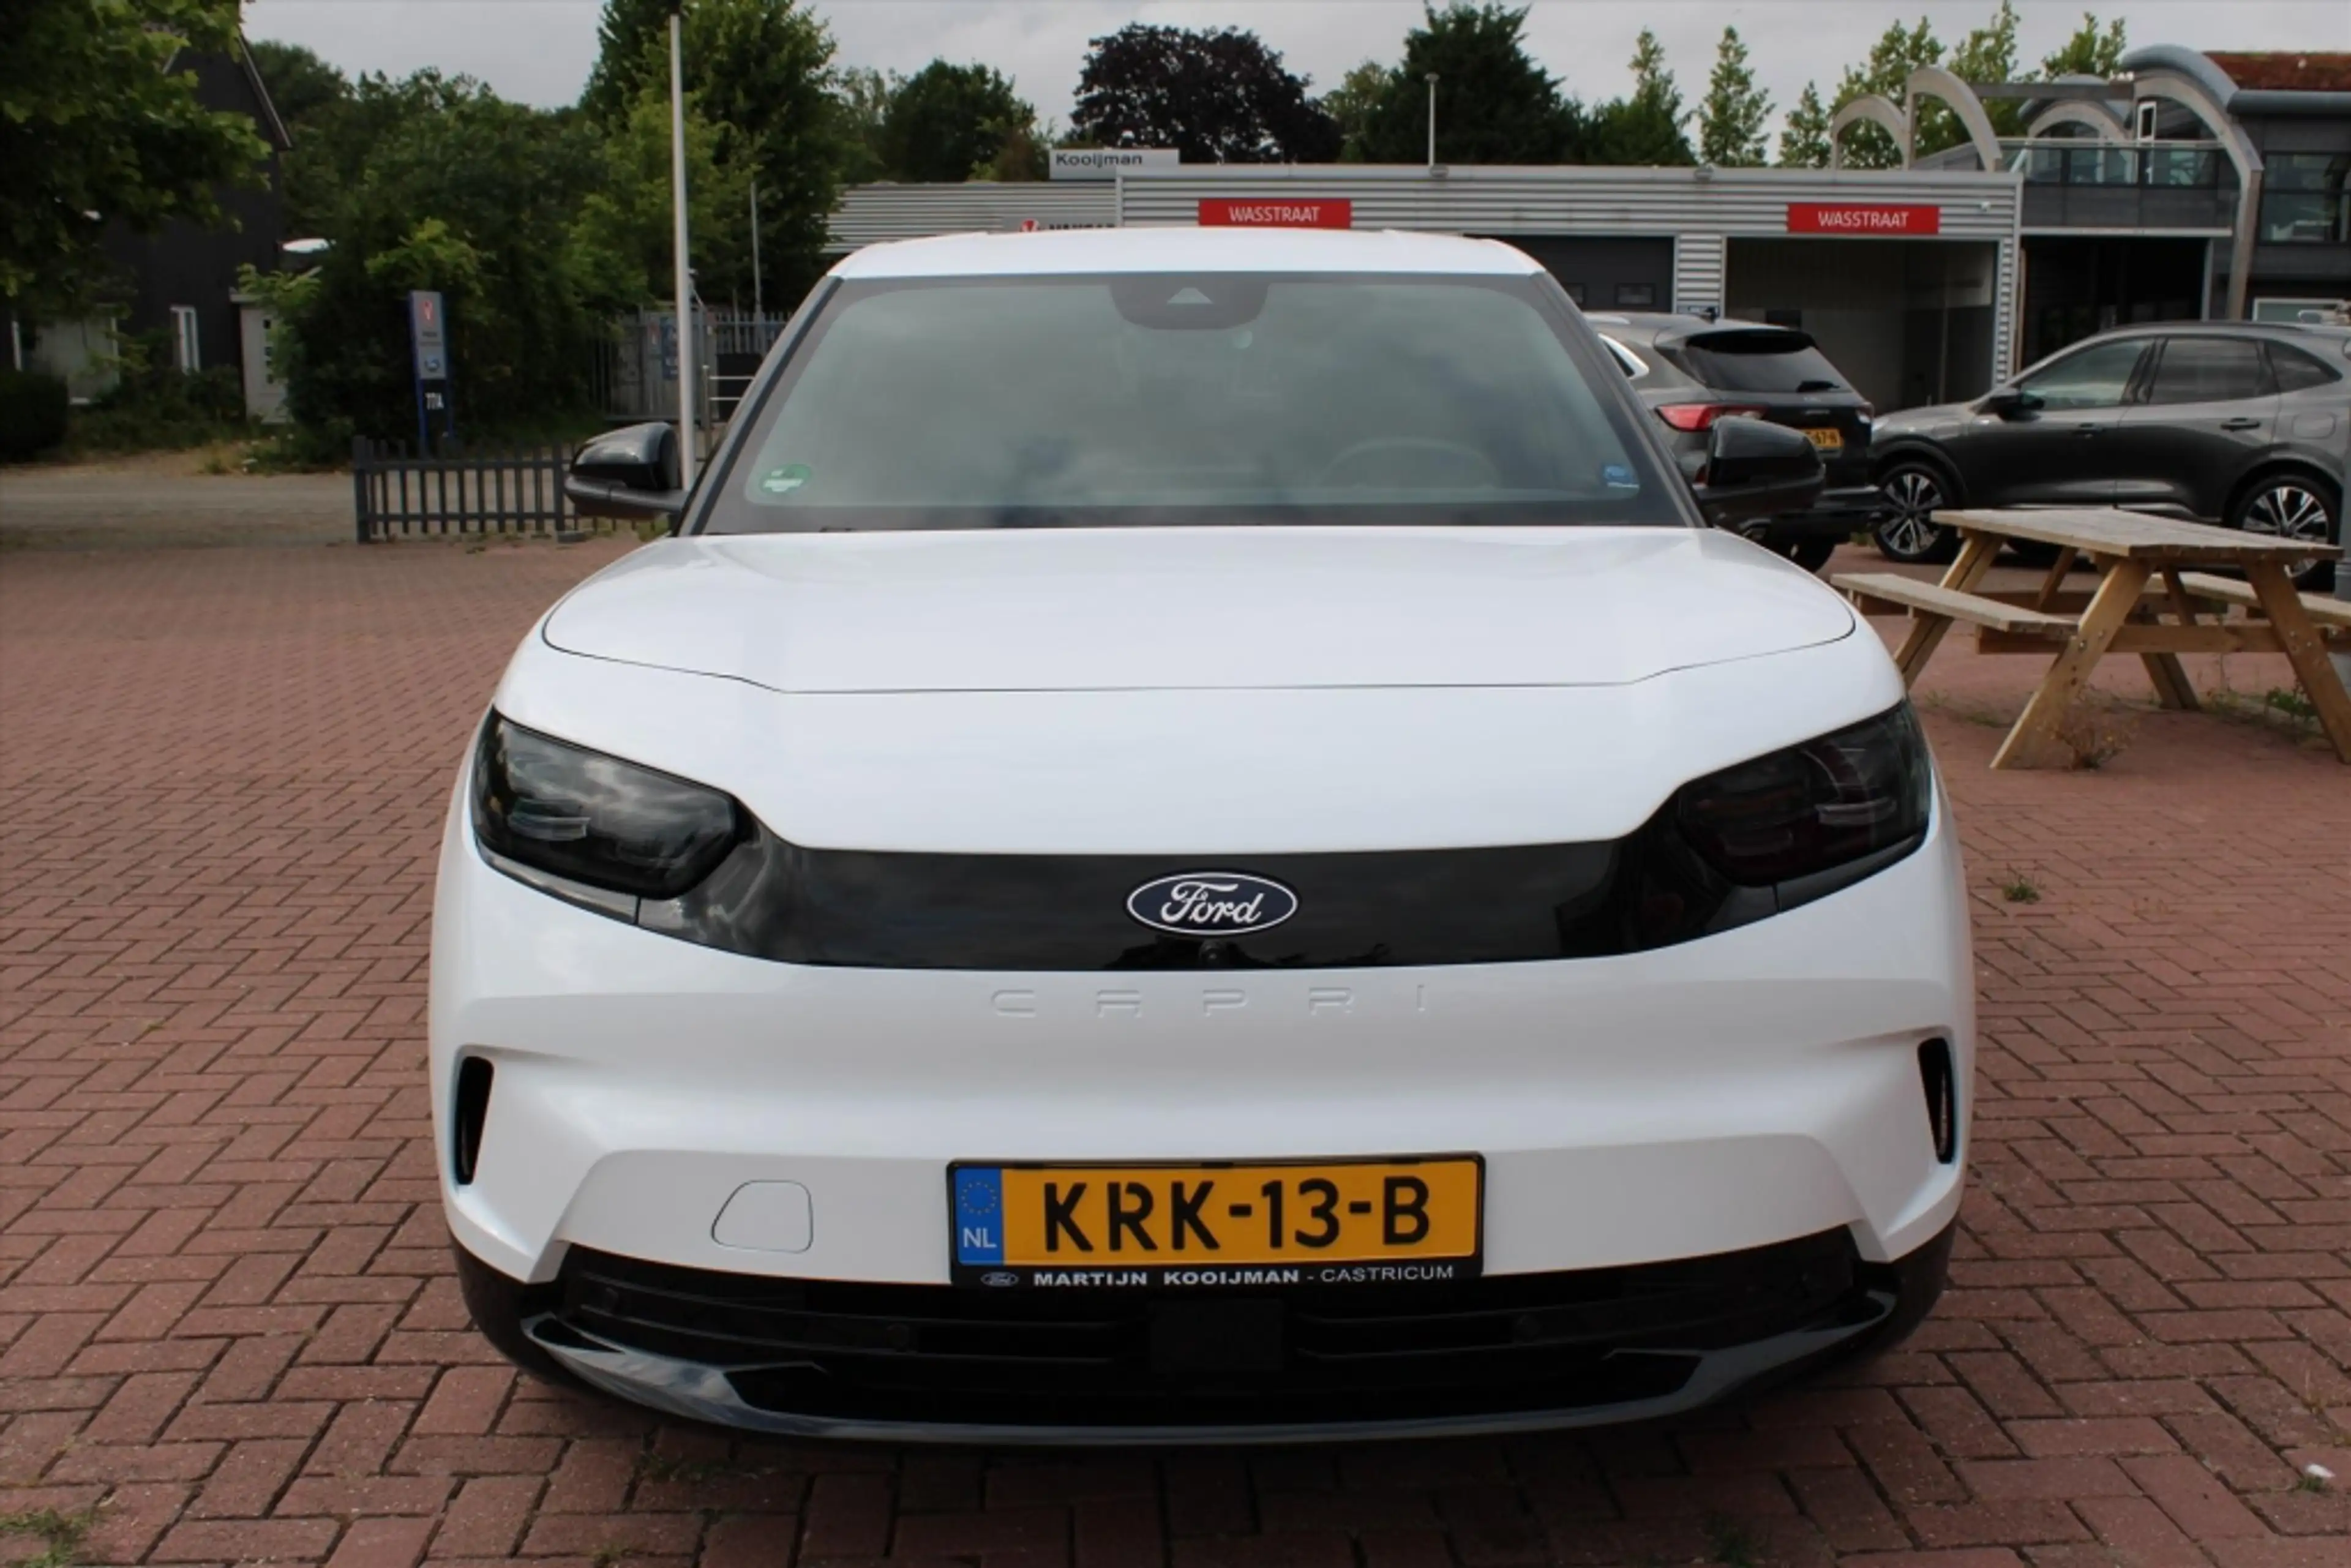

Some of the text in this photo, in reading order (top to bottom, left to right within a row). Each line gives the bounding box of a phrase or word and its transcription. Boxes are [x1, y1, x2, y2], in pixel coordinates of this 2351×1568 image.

[1056, 154, 1142, 168] Kooijman
[1229, 206, 1321, 222] WASSTRAAT
[1818, 211, 1909, 227] WASSTRAAT
[1161, 882, 1264, 923] Ford
[990, 984, 1425, 1018] CAPRI
[1044, 1176, 1430, 1253] KRK-13-B
[963, 1228, 997, 1248] NL
[1034, 1272, 1147, 1286] MARTIJN
[1164, 1270, 1299, 1285] KOOIJMAN
[1321, 1266, 1453, 1283] CASTRICUM
